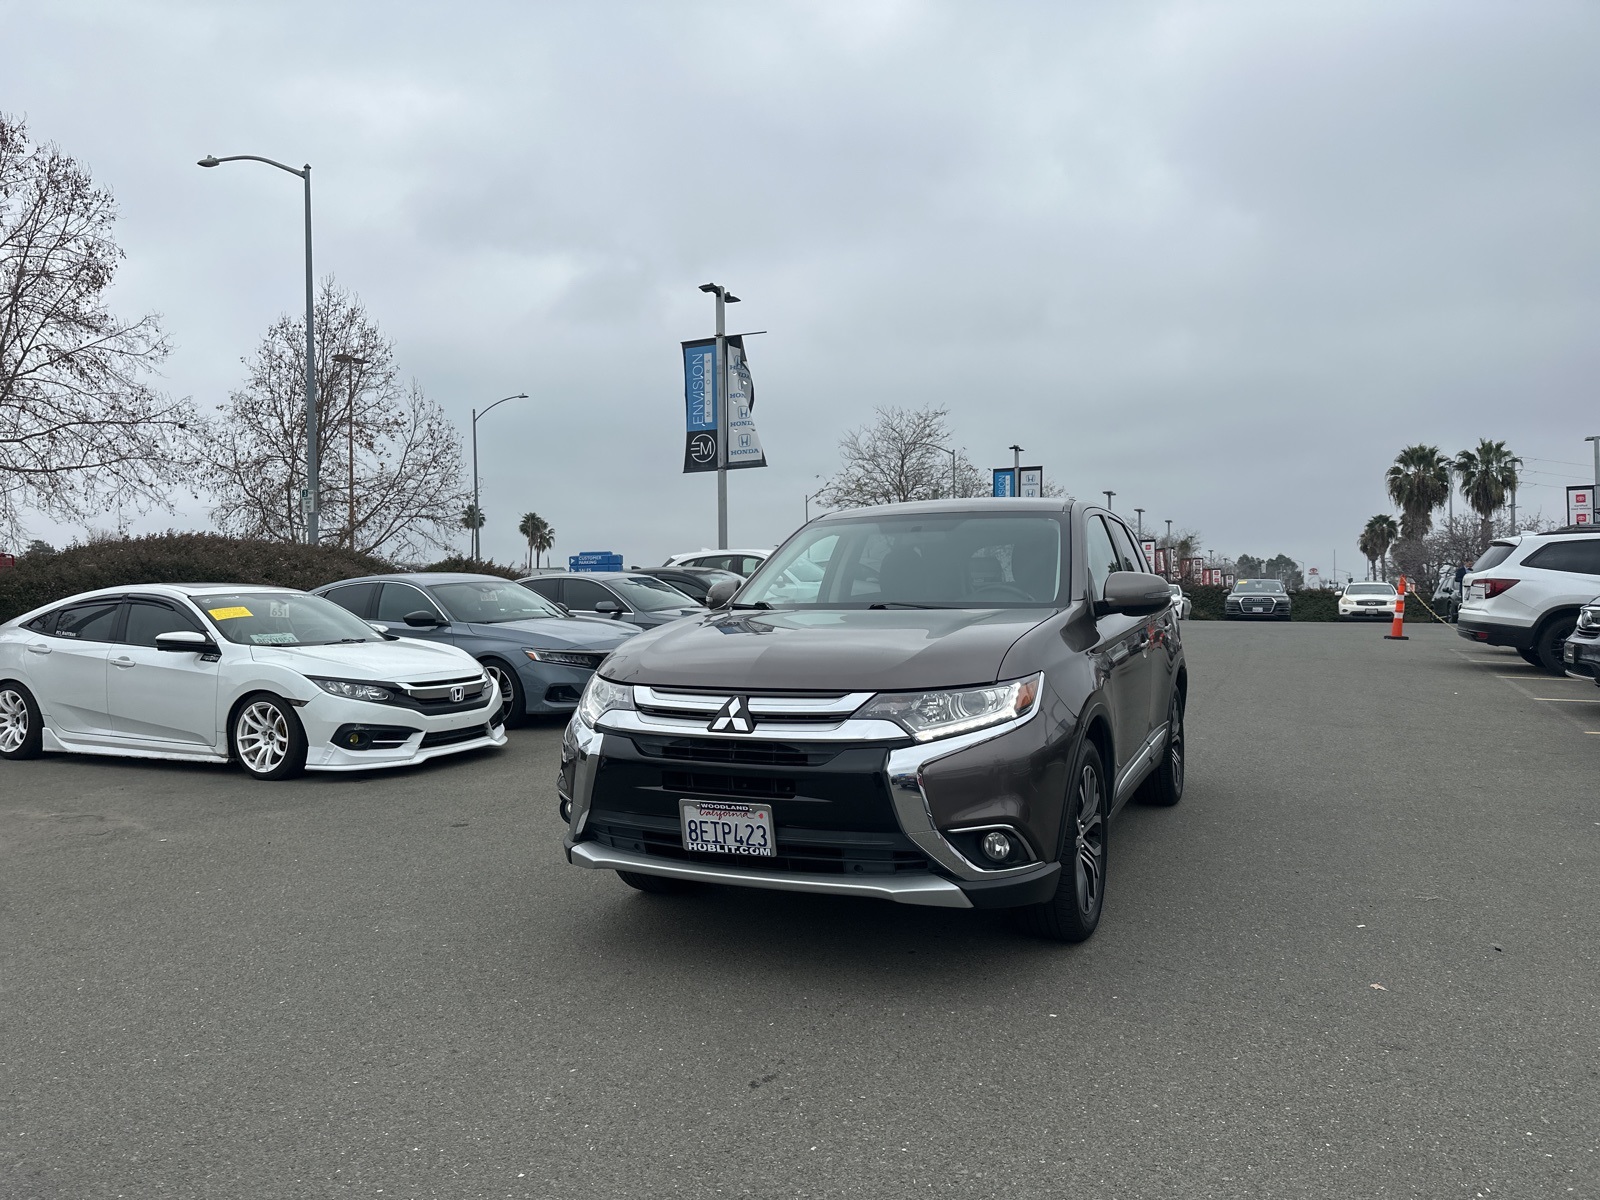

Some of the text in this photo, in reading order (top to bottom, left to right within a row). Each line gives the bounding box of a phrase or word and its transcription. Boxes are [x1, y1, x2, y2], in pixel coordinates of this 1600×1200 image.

[692, 353, 704, 425] ENVISION
[730, 448, 759, 456] HONDA
[272, 608, 287, 617] 651
[700, 803, 749, 811] WOODLAND
[699, 809, 755, 820] California
[687, 819, 768, 847] 8EIP423
[688, 842, 771, 856] HOBLIT.COM
